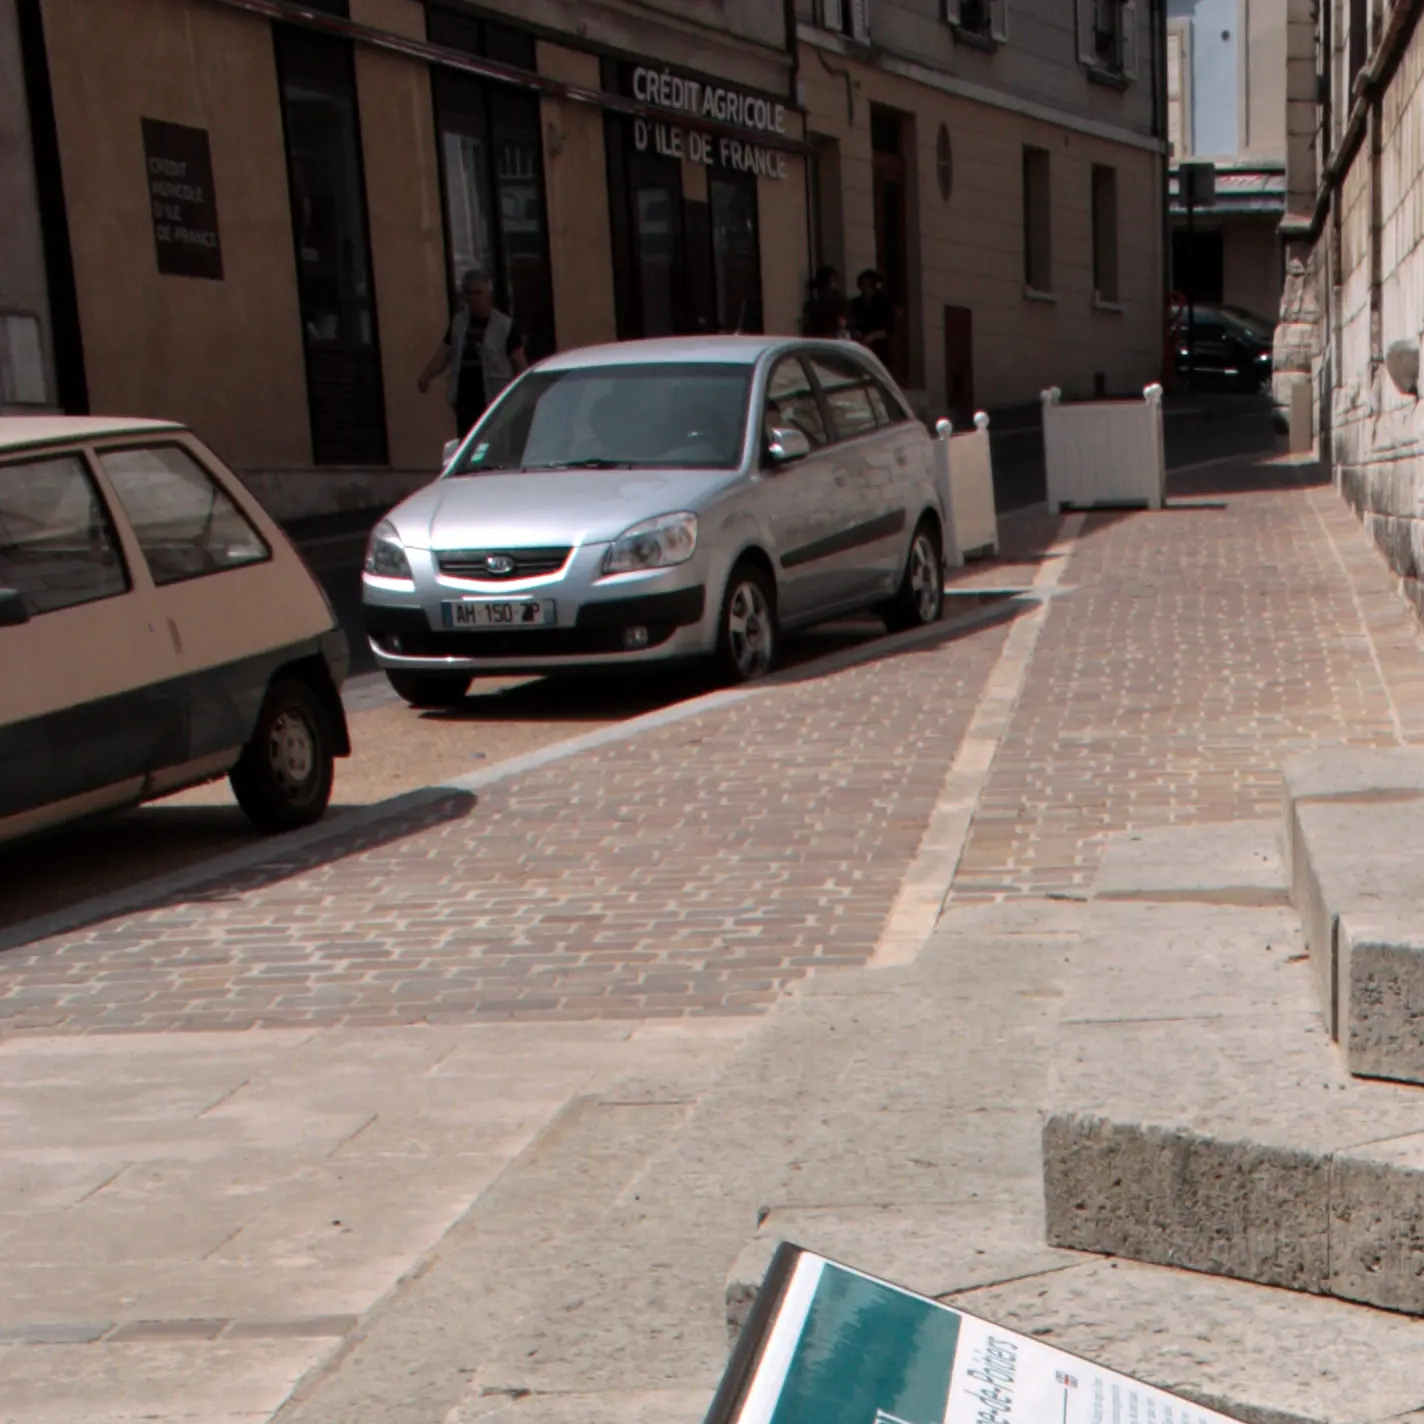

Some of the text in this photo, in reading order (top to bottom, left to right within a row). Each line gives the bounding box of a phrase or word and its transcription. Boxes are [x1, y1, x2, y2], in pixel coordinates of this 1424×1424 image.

[632, 66, 785, 132] CRÉDIT AGRICOLE
[689, 131, 714, 165] DE
[720, 138, 787, 179] FRANCE
